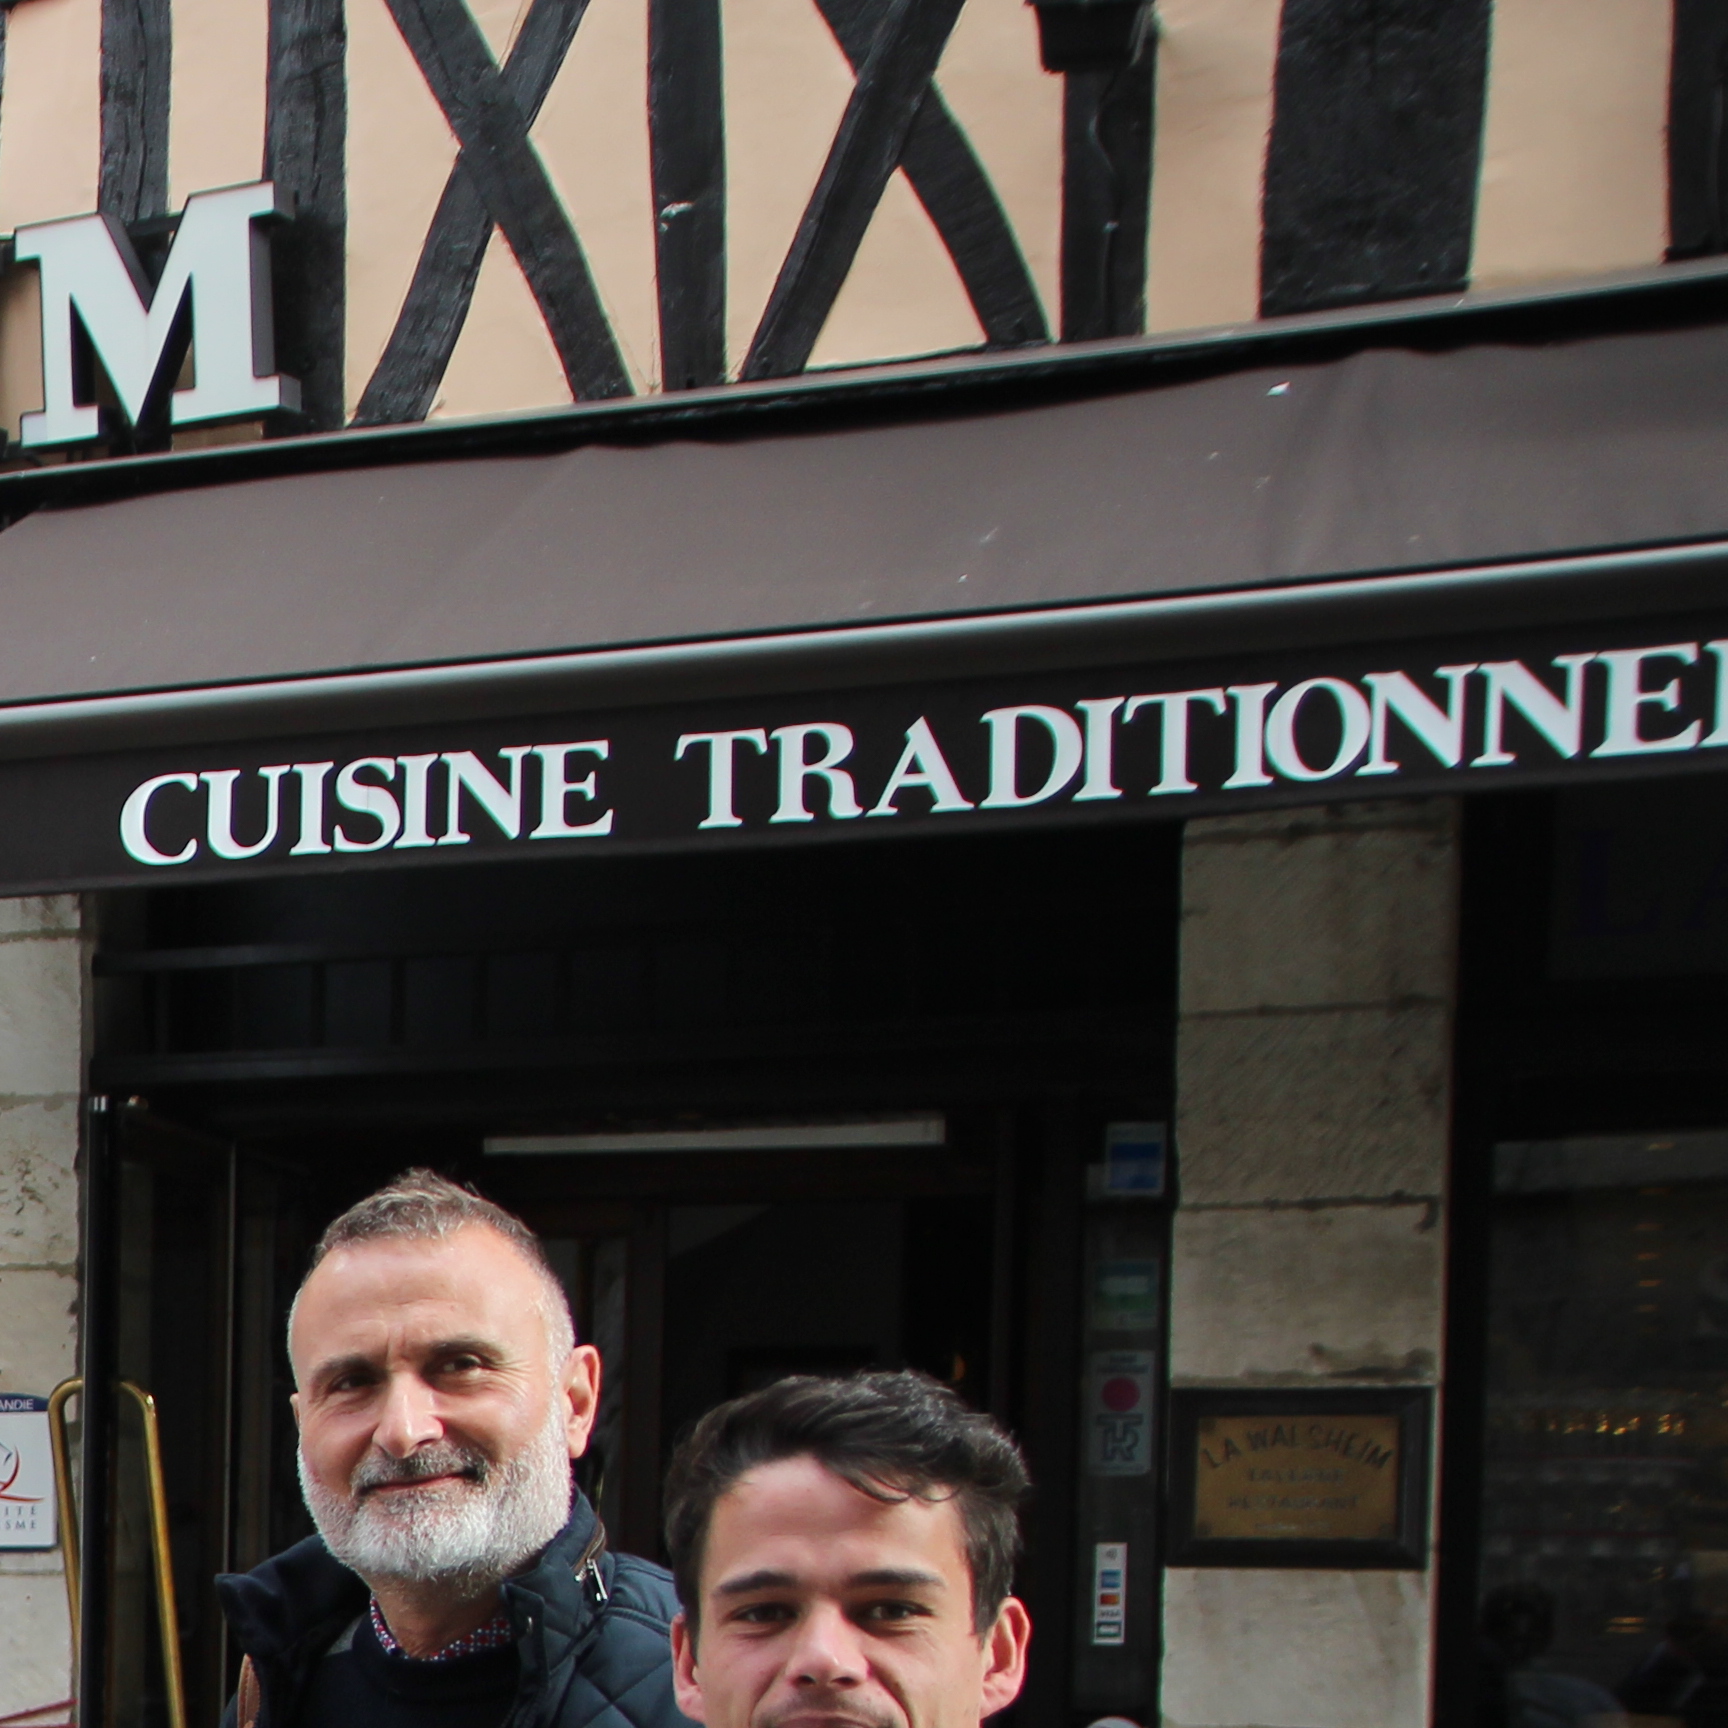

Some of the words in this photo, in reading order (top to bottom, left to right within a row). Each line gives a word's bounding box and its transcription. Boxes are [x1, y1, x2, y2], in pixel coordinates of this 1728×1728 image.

[118, 738, 615, 867] CUISINE
[673, 640, 1728, 830] TRADITIONNE
[1202, 1438, 1242, 1470] LA
[1246, 1423, 1393, 1470] WALSHEIM
